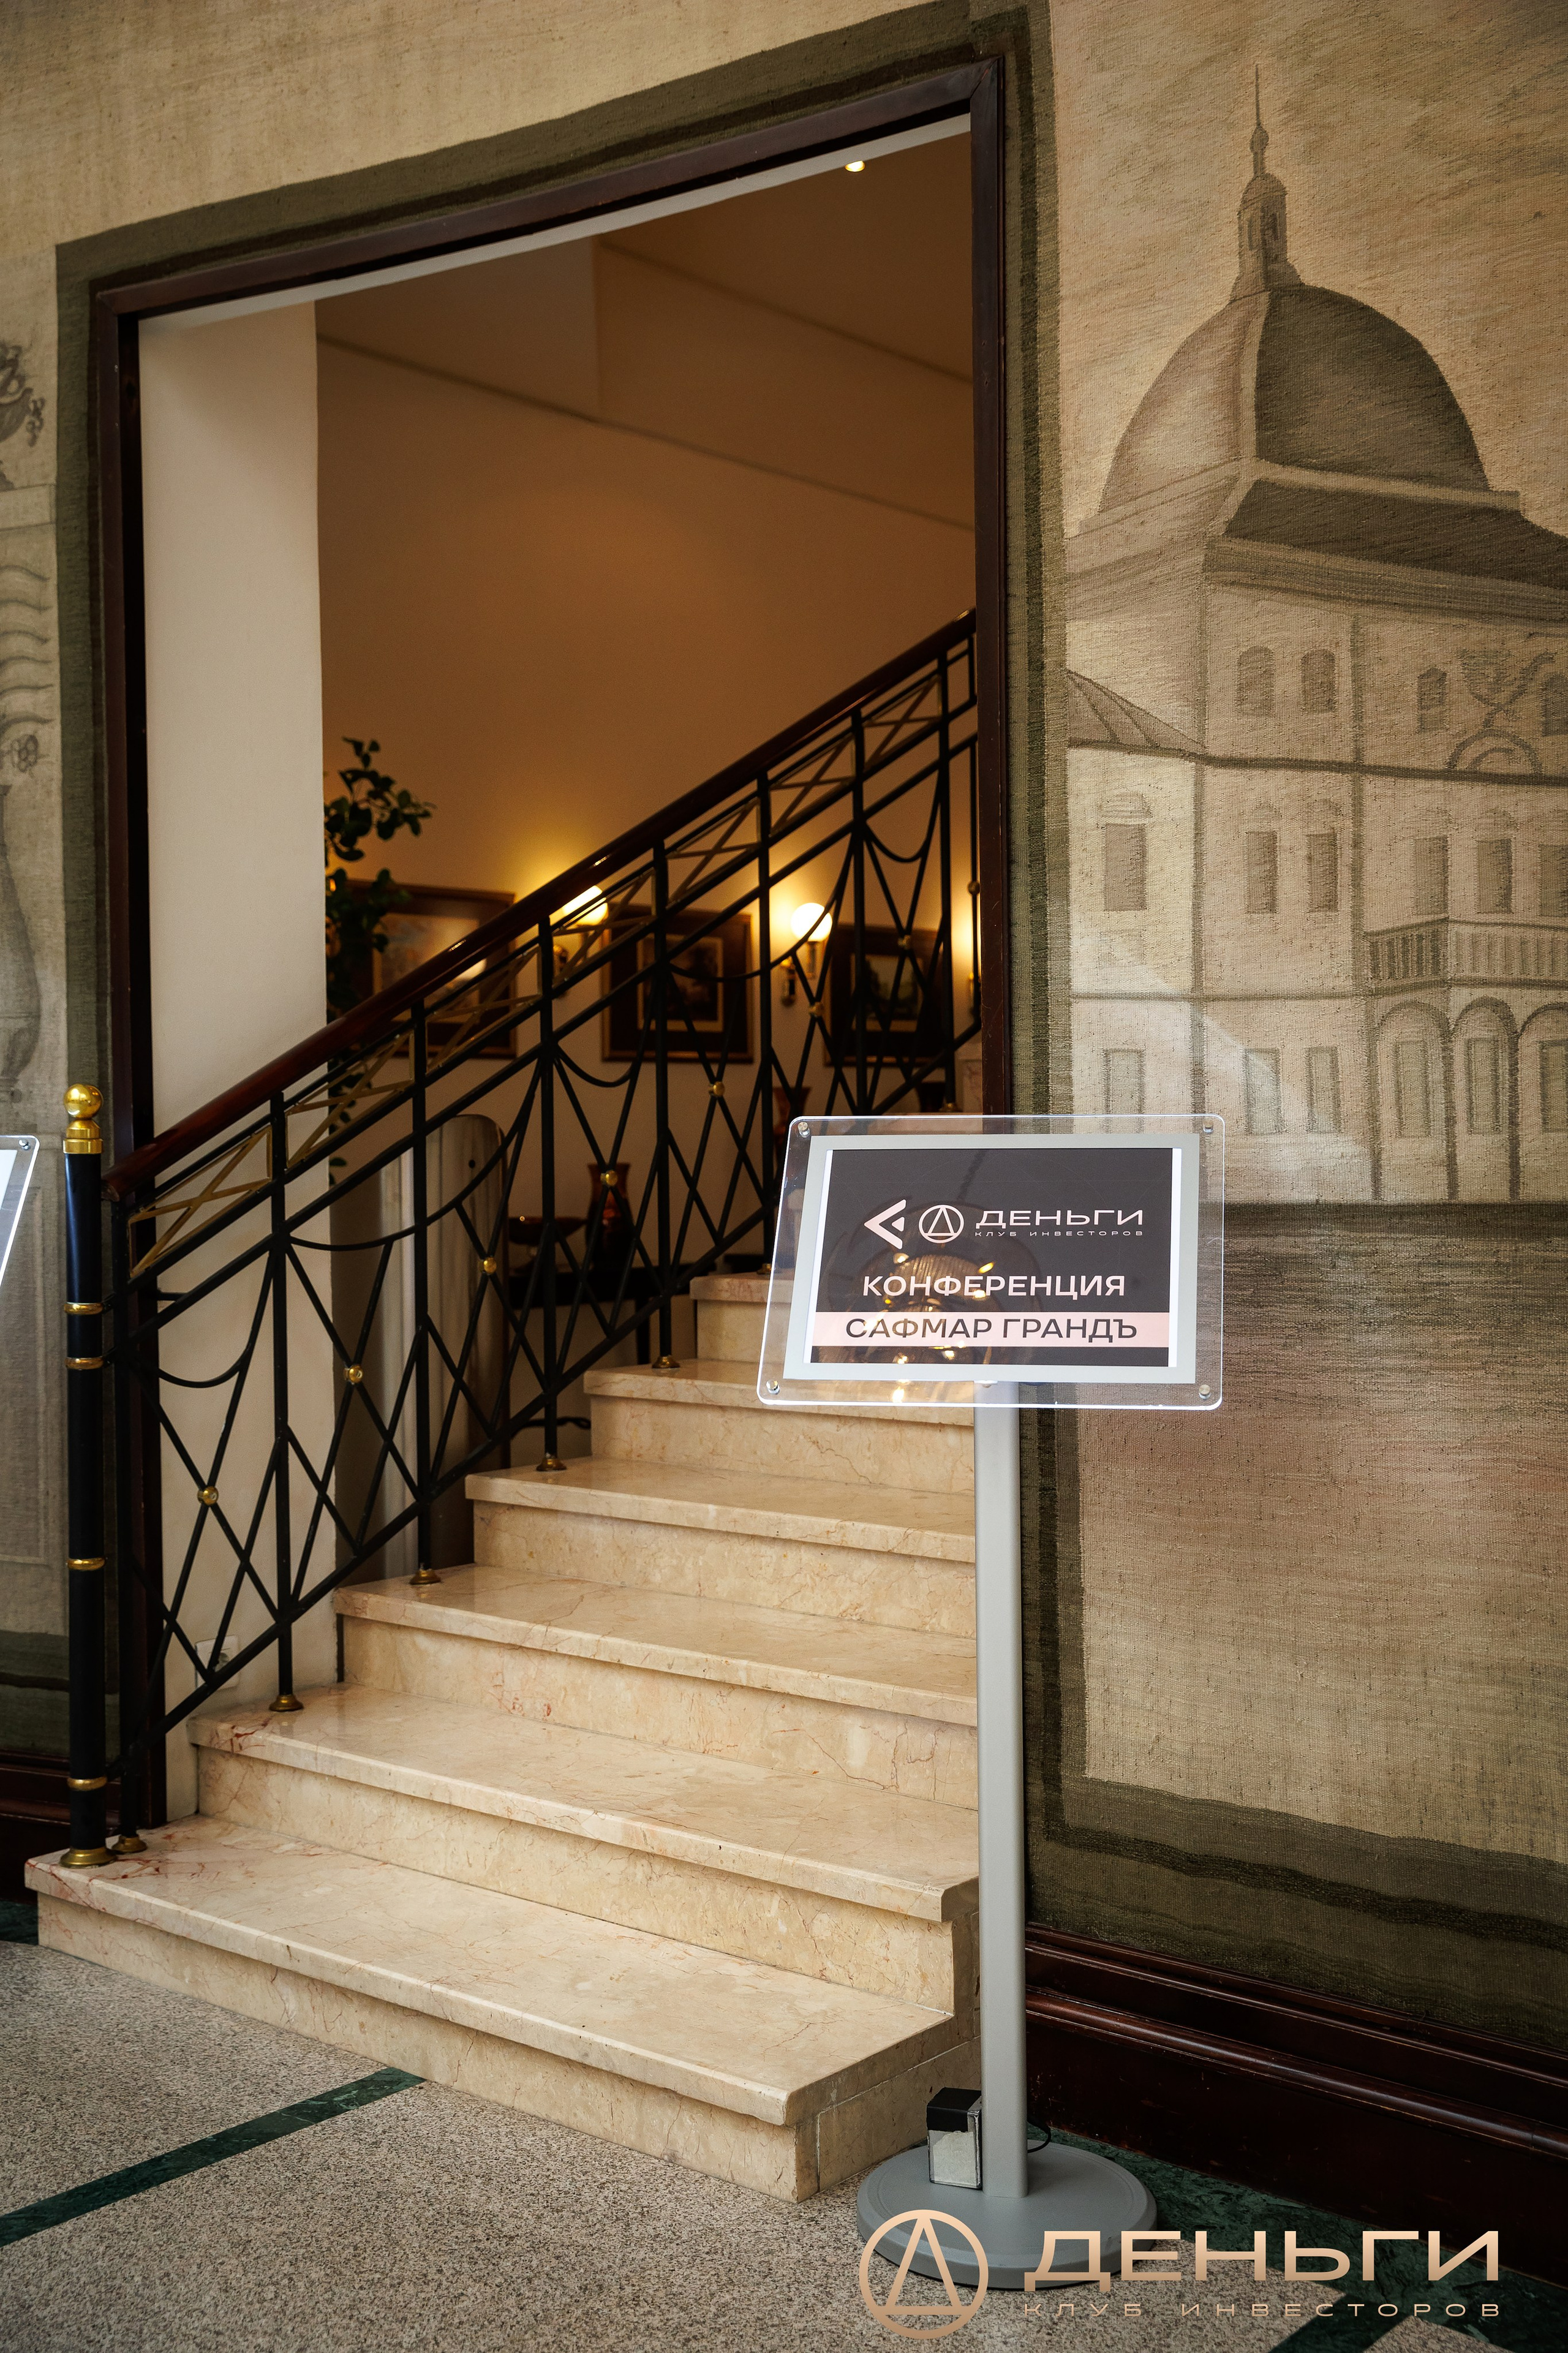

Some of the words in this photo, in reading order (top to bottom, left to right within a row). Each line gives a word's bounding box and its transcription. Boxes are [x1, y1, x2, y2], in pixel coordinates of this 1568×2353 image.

[975, 1209, 1143, 1229] ДЕНЬГИ
[862, 1275, 1125, 1301] КОНФЕРЕНЦИЯ
[846, 1318, 992, 1339] САФМАР
[1003, 1318, 1137, 1343] ГРАНДЪ
